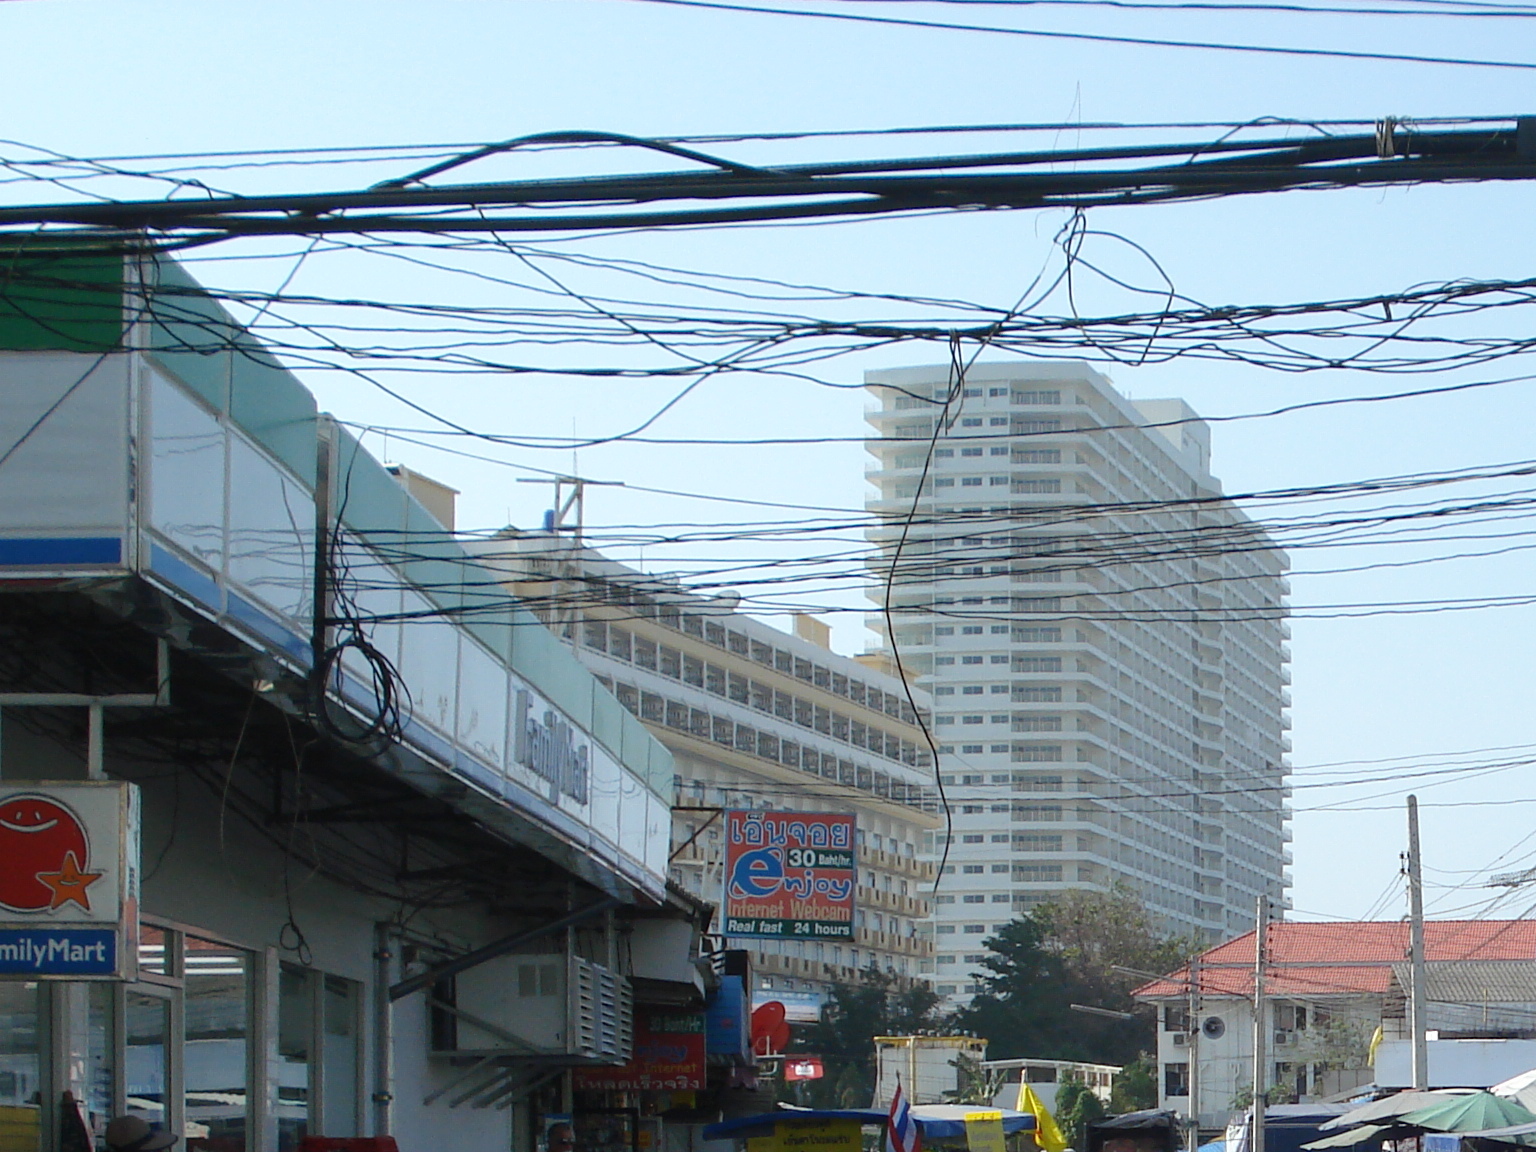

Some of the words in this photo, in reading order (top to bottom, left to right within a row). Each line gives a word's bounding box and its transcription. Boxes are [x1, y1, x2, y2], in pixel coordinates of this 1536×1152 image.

[514, 689, 588, 806] FamilyMart
[731, 812, 851, 849] เอ็นจอย
[788, 848, 816, 868] 30
[728, 845, 852, 902] enjoy
[727, 897, 784, 919] Internet
[789, 898, 850, 921] Webcam
[727, 918, 755, 933] Real
[759, 919, 784, 933] fast
[794, 921, 810, 934] 24
[814, 922, 850, 936] hours
